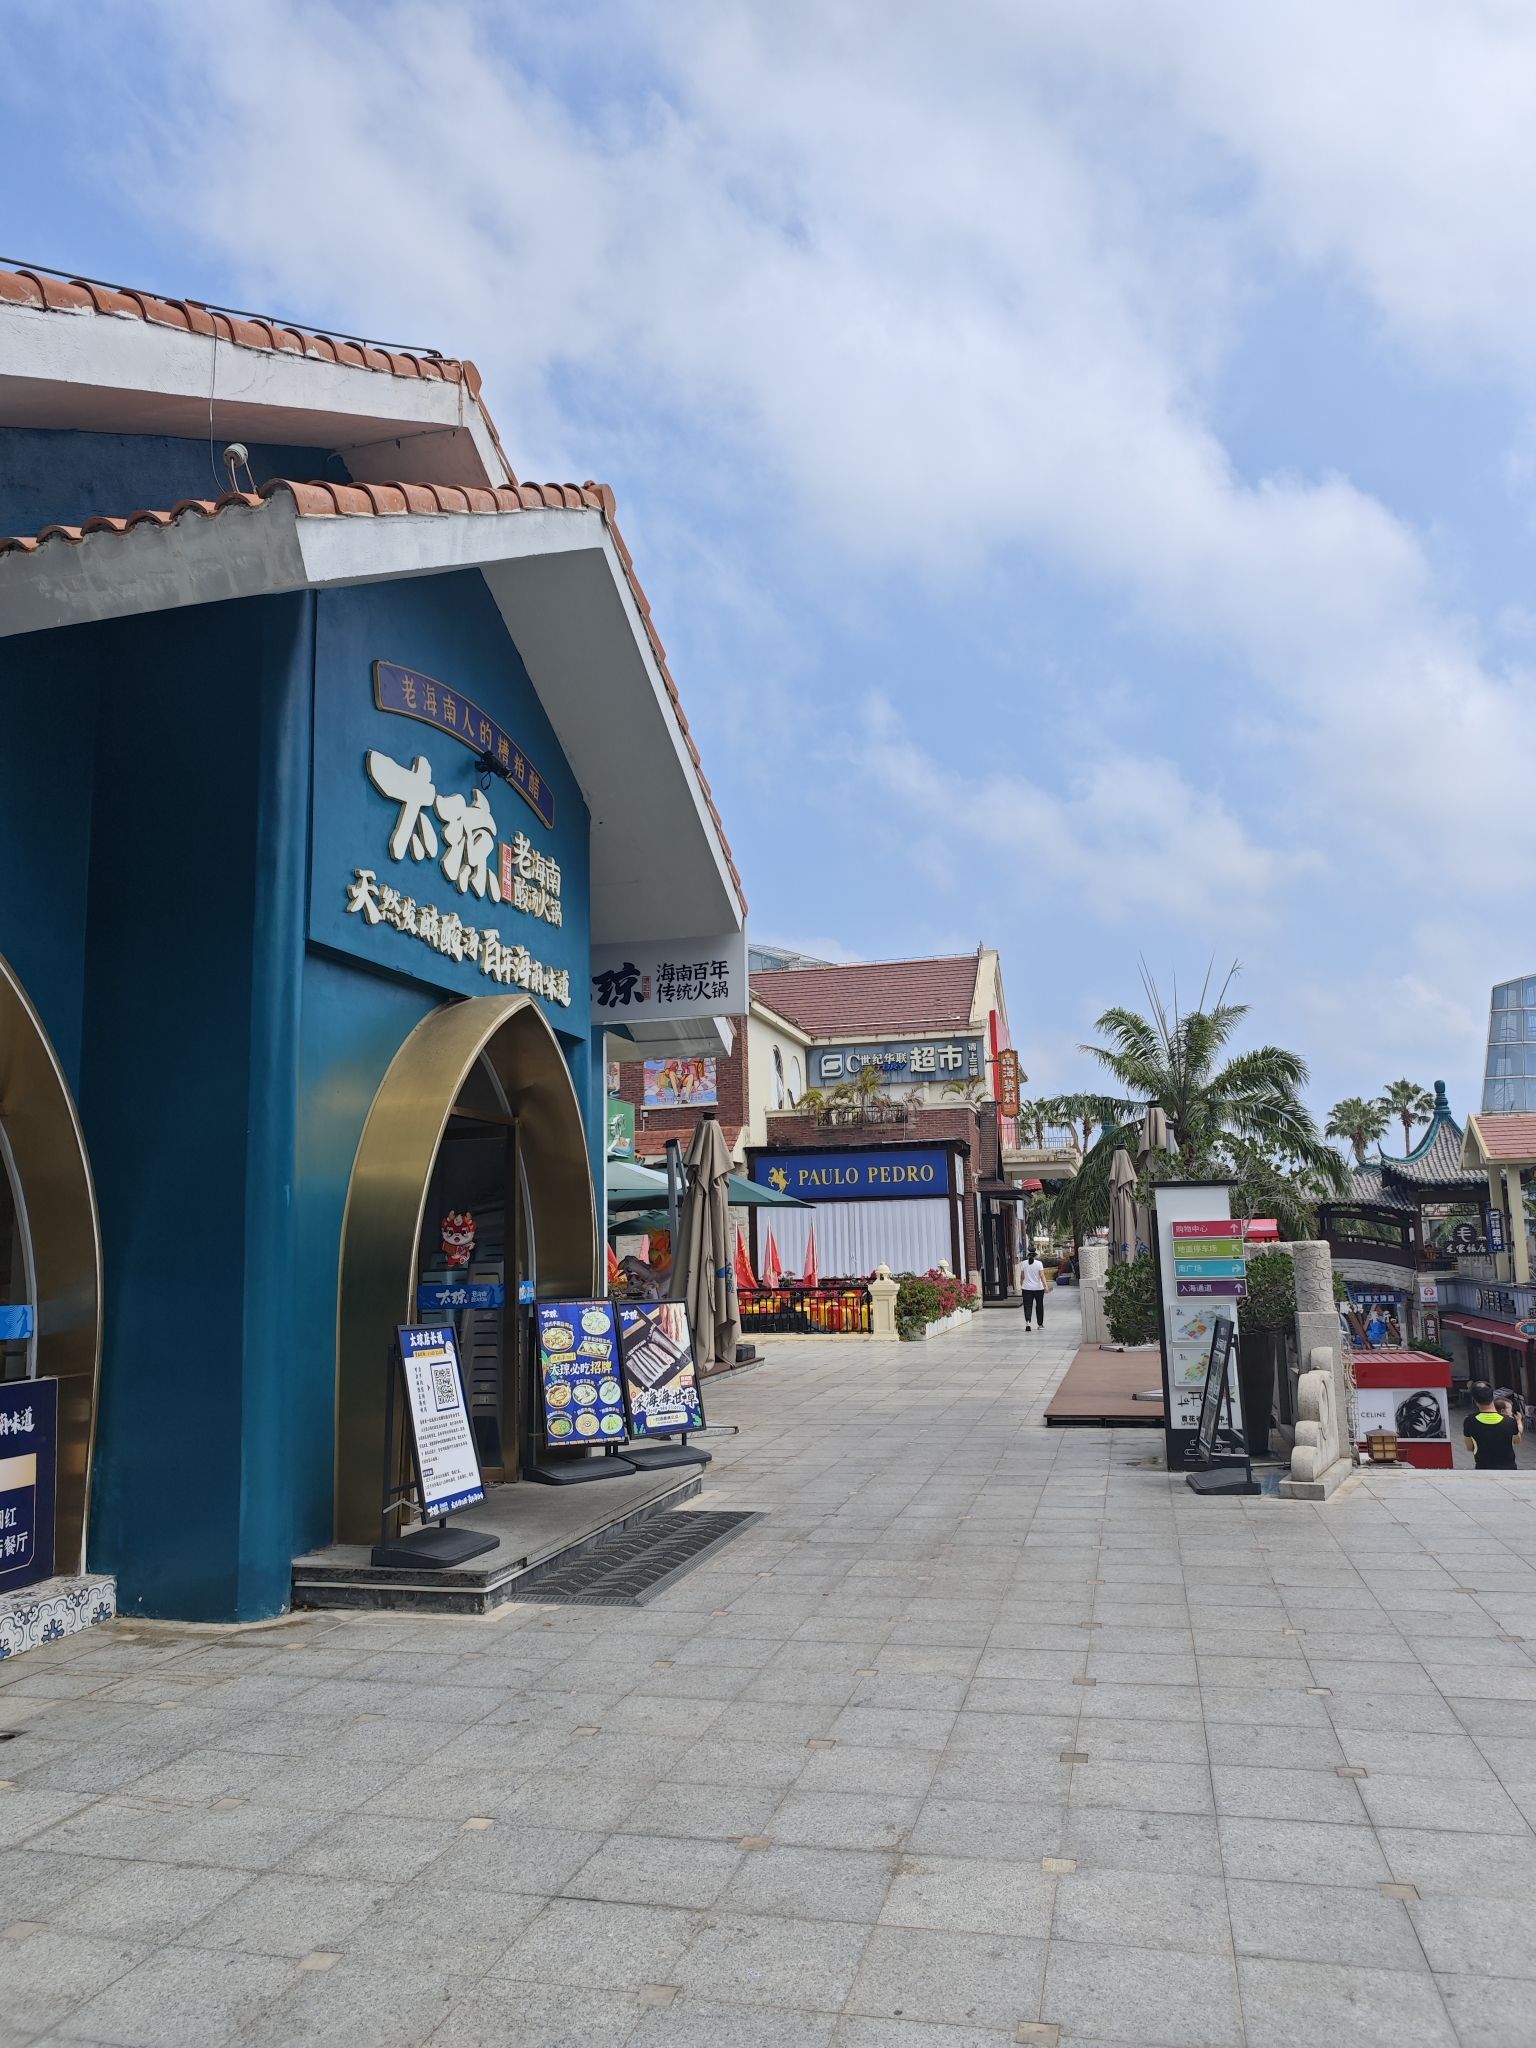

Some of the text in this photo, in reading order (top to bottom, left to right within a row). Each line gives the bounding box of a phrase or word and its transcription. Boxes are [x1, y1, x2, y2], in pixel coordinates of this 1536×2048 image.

[656, 960, 729, 982] 海南百年
[591, 962, 645, 1008] 琼
[655, 980, 728, 1003] 传统火锅
[798, 1164, 934, 1187] PAULO PEDRO
[1175, 1225, 1208, 1233] 购物中心
[1457, 1227, 1472, 1242] 毛
[1180, 1284, 1213, 1293] 入海通道
[550, 1360, 613, 1376] 太琼必吃招牌
[0, 1531, 28, 1559] 餐厅
